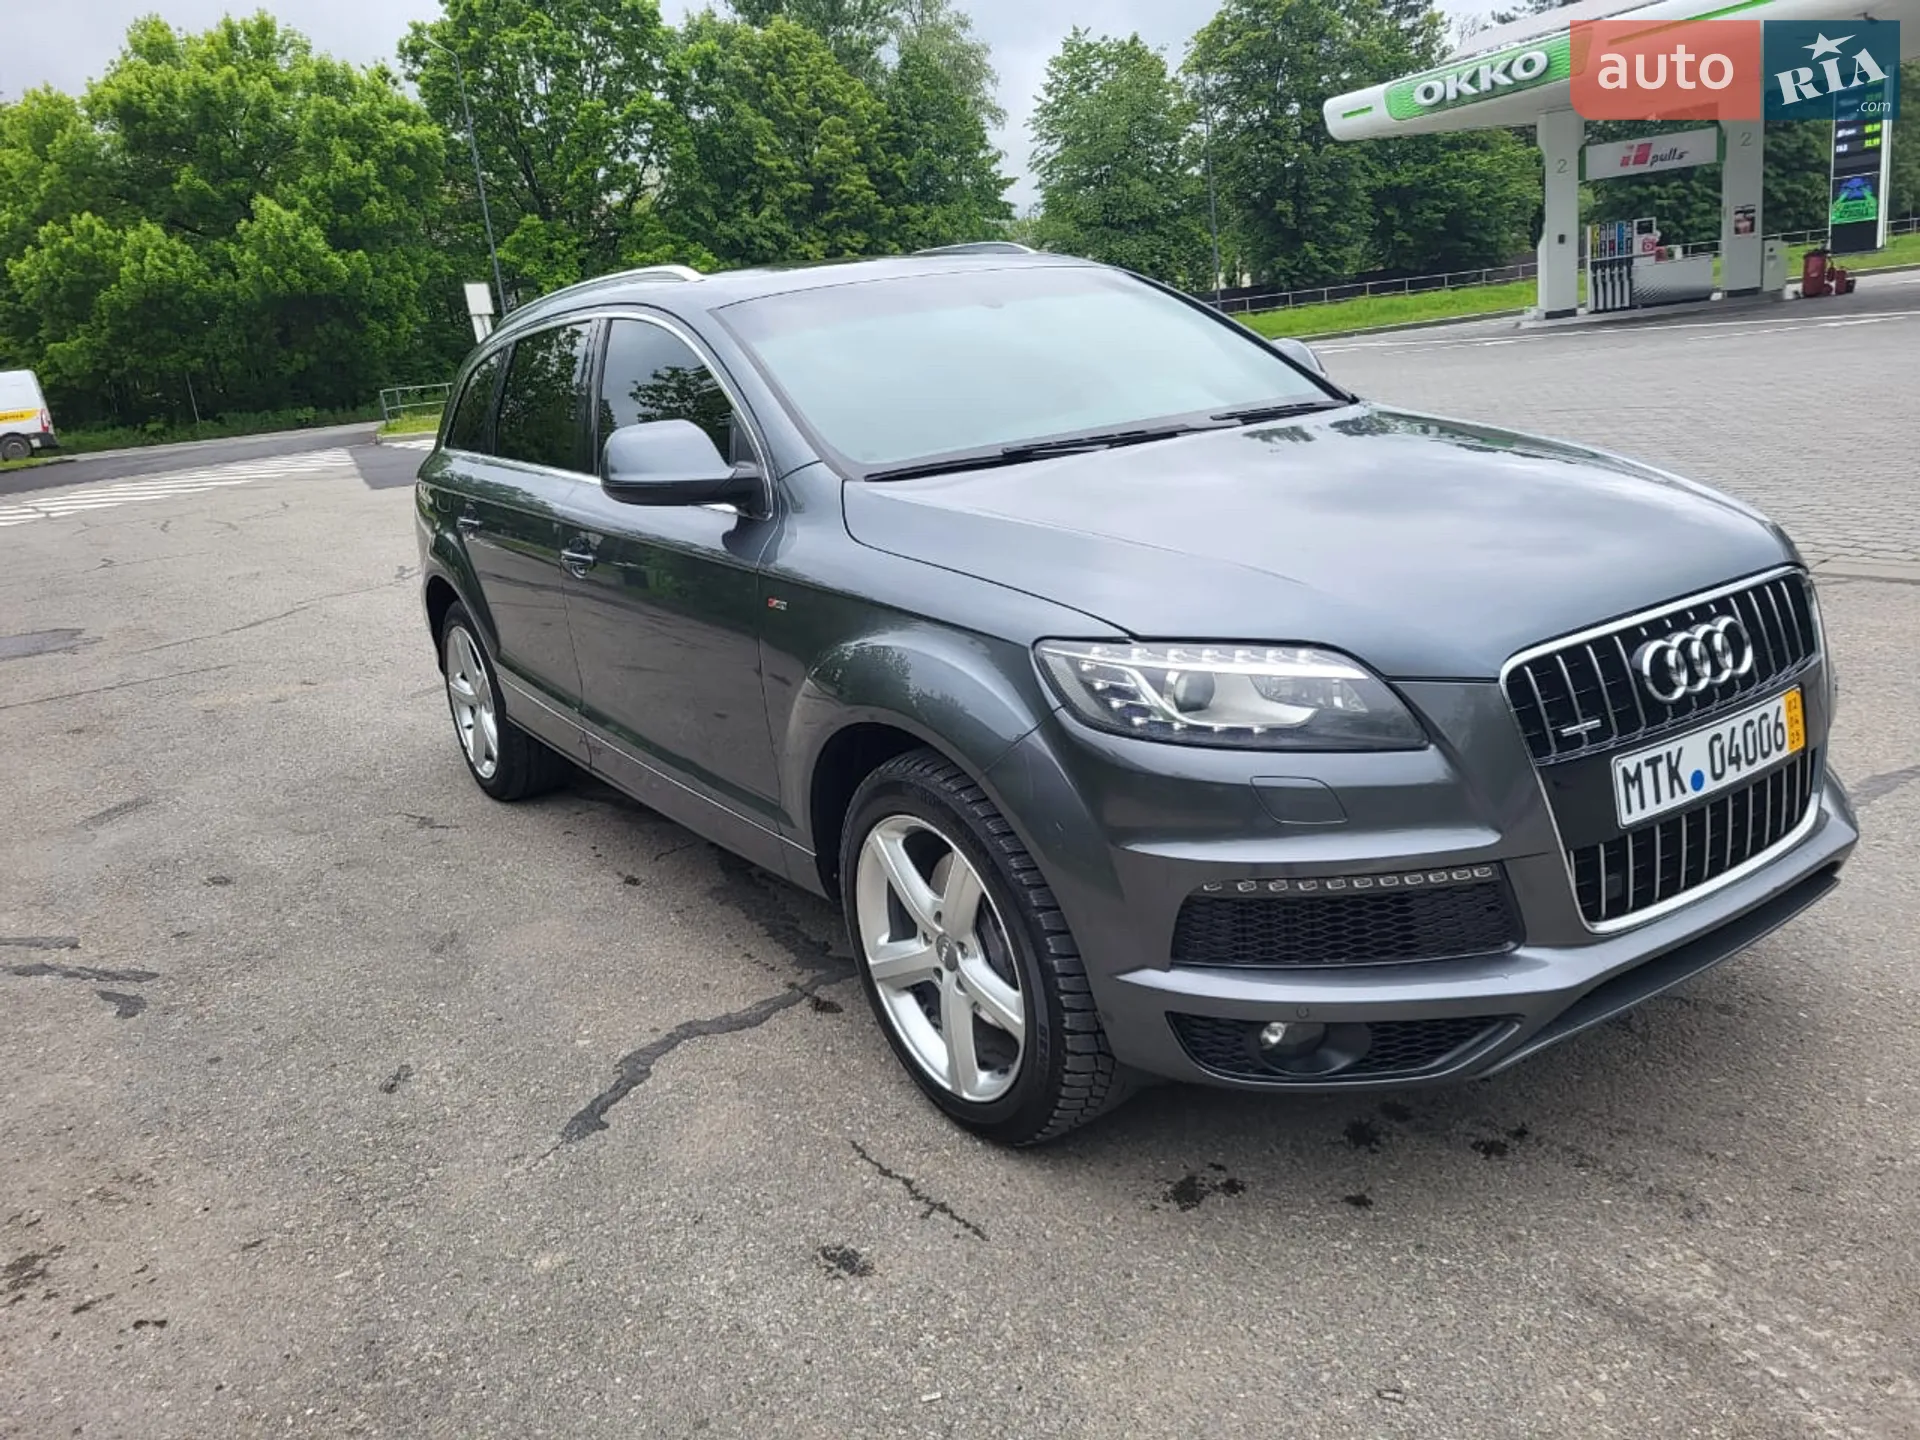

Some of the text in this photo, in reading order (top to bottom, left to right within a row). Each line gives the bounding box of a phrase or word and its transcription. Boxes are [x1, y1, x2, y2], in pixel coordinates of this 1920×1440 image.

[1413, 50, 1548, 107] OKKO
[1740, 131, 1751, 147] 2
[1556, 158, 1568, 173] 2
[1649, 147, 1689, 167] pulls
[1622, 746, 1687, 815] MTK
[1708, 705, 1786, 781] 04006
